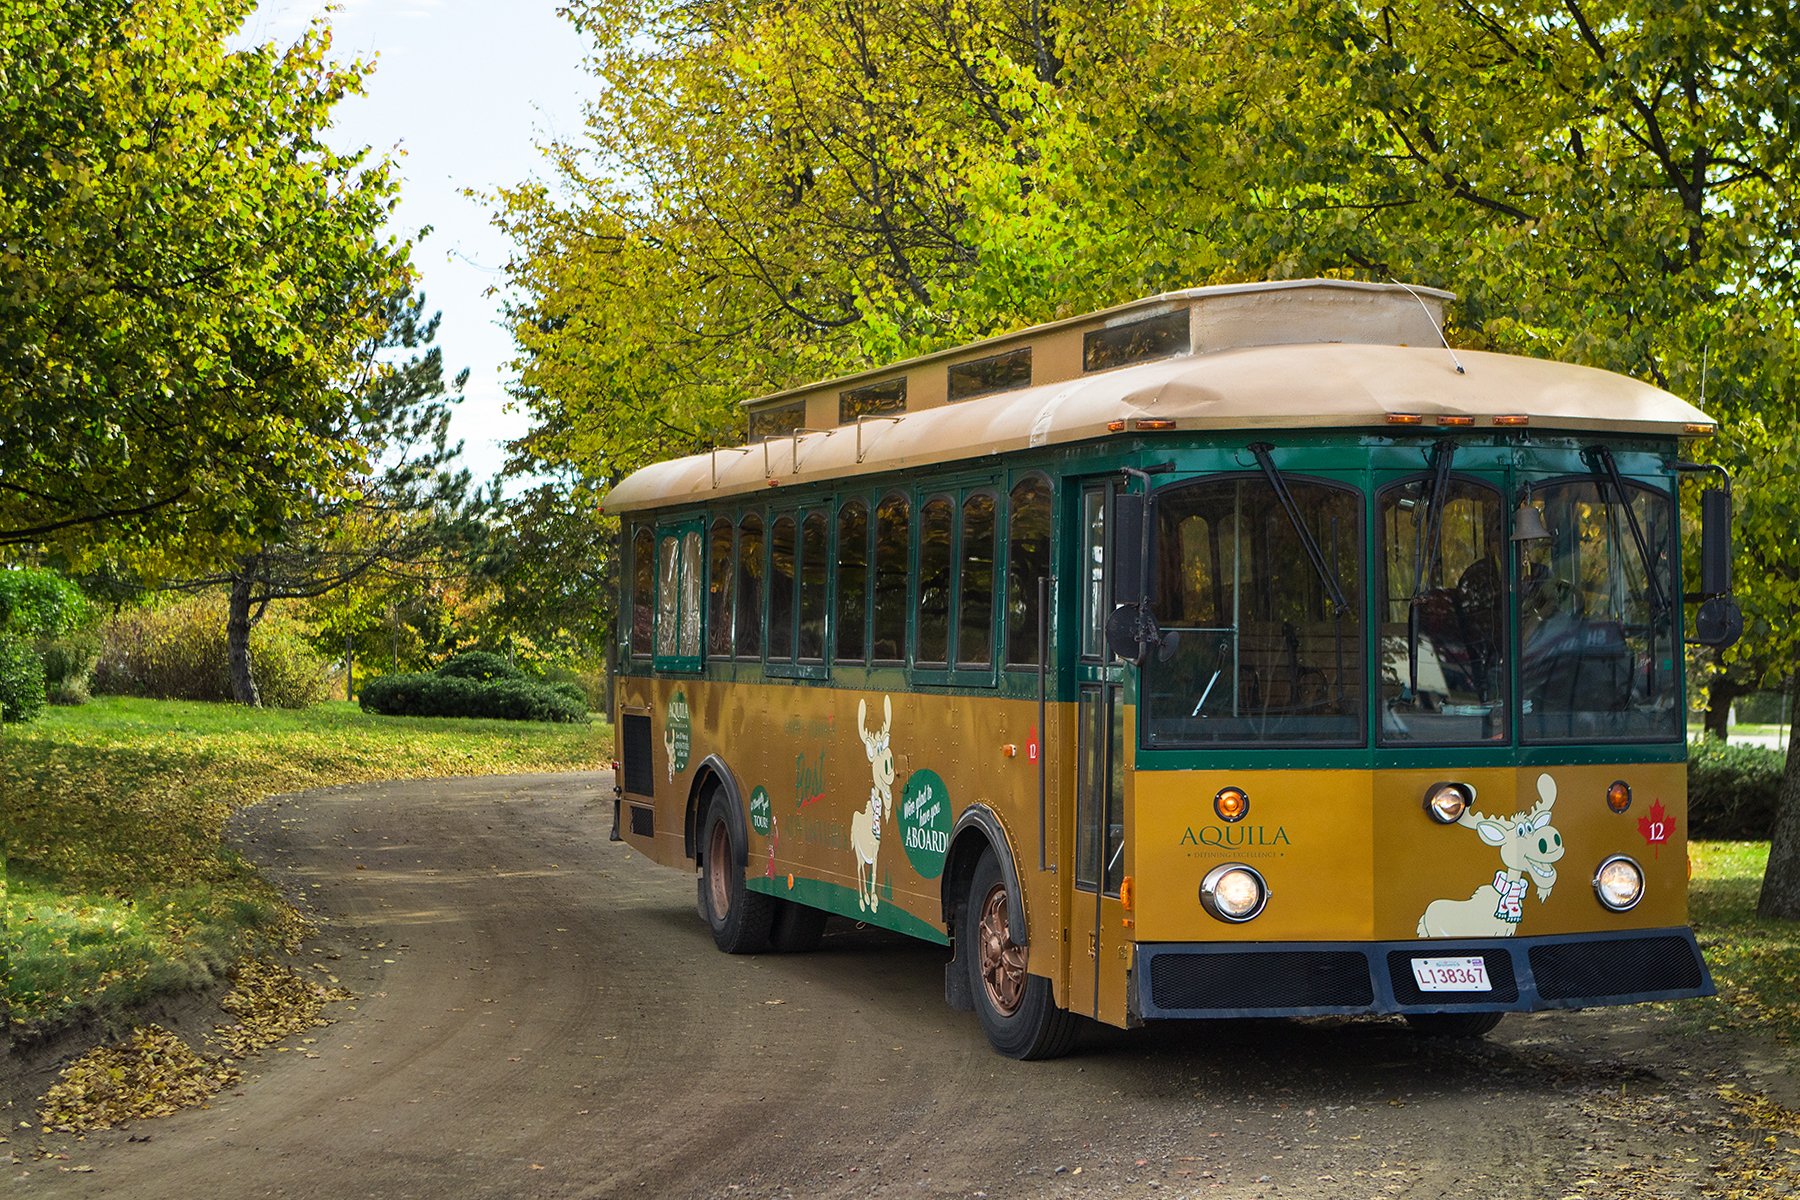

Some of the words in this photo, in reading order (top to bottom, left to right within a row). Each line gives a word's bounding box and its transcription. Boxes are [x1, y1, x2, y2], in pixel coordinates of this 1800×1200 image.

[668, 702, 689, 722] AQUILA
[1029, 743, 1037, 759] 12
[1179, 825, 1291, 850] AQUILA
[1648, 822, 1665, 840] 12
[1417, 968, 1484, 984] L138367
